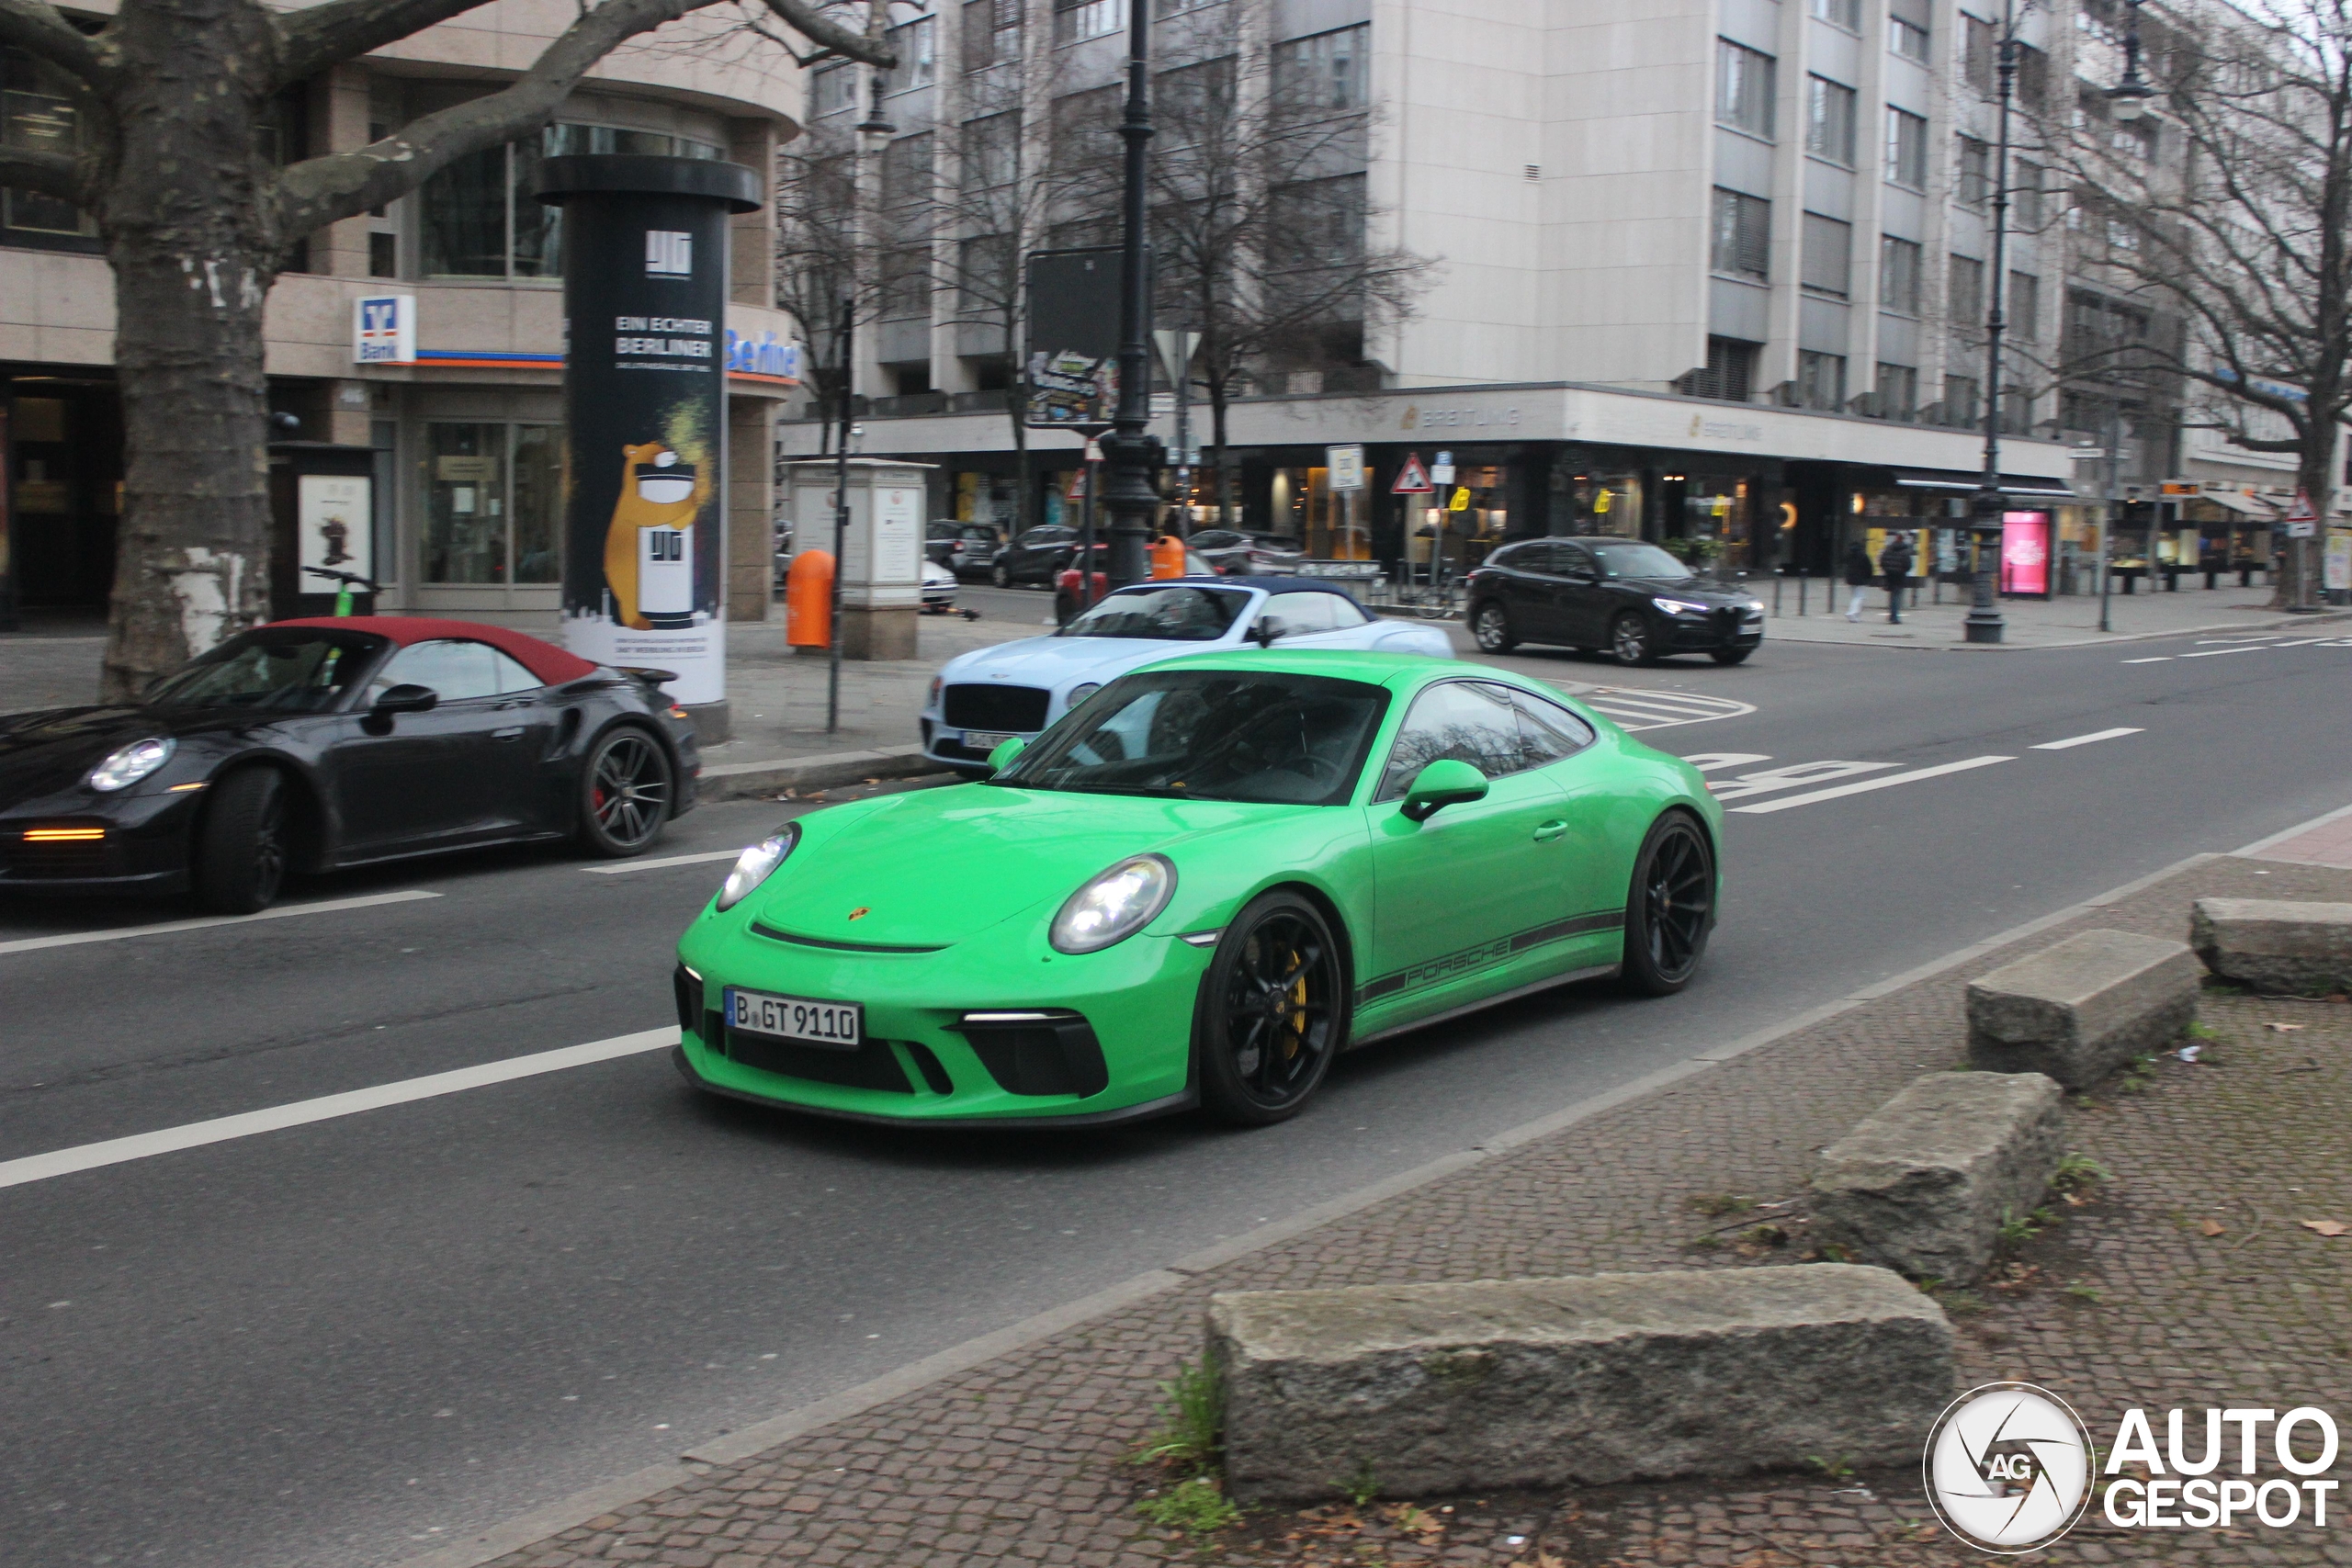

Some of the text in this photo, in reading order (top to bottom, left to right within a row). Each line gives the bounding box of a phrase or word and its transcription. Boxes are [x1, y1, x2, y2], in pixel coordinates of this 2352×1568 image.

[615, 316, 713, 334] EIN ECHTER
[360, 339, 397, 360] Bank
[615, 337, 713, 357] BERLINER
[1421, 407, 1521, 428] BREITLING
[1406, 940, 1509, 986] PORSCHE
[736, 995, 854, 1040] B GT 9110
